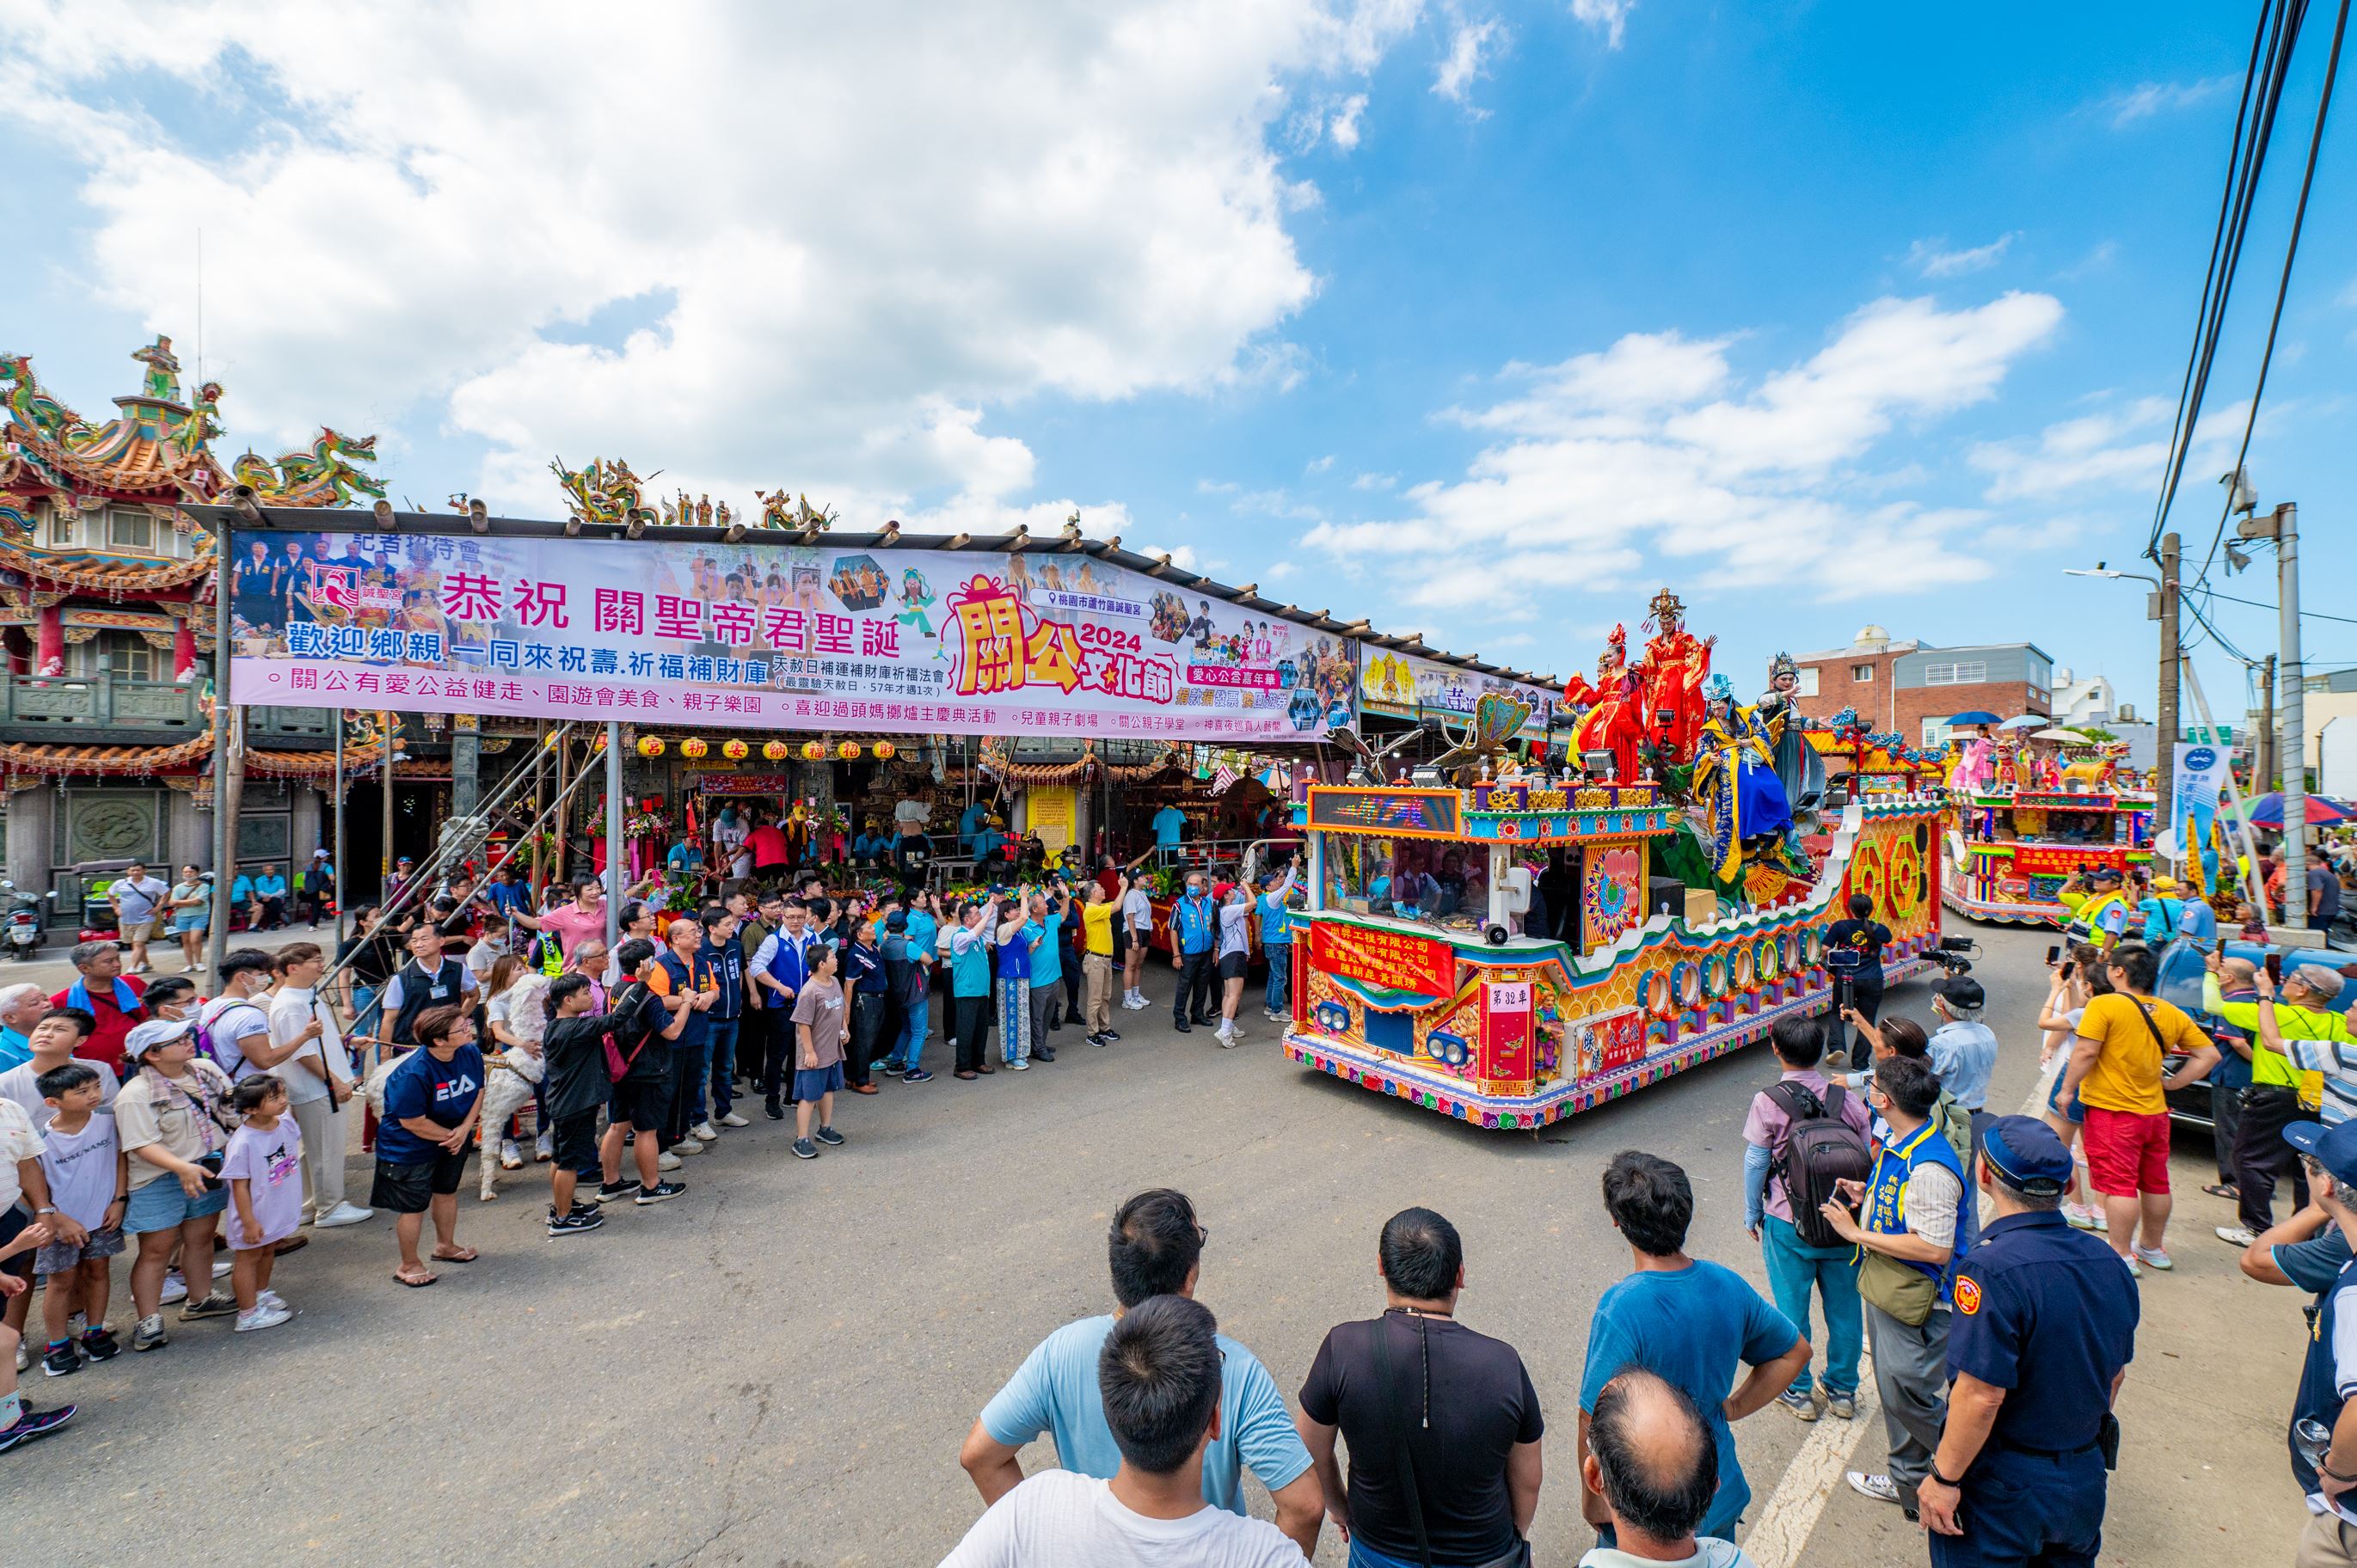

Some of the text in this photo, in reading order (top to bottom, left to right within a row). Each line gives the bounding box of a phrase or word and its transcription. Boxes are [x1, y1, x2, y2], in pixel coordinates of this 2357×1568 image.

[362, 586, 402, 600] 誠聖宮
[443, 573, 899, 658] 恭祝 關聖帝君聖誕
[1059, 594, 1140, 616] 桃園市蘆竹區誠聖宮
[289, 622, 441, 662] 歡迎鄉親
[1080, 623, 1142, 652] 2024
[774, 657, 944, 683] 天赦日補運補財庫祈福法會
[1194, 668, 1275, 686] 愛心公益嘉年華
[1175, 687, 1239, 707] 捐款捐發票
[1022, 710, 1098, 728] 兒童親子劇場
[1119, 714, 1185, 731] 關公親子學堂
[646, 738, 894, 758] 宮 祈 安 納 福 招 財
[1493, 989, 1527, 1007] 第 32 車
